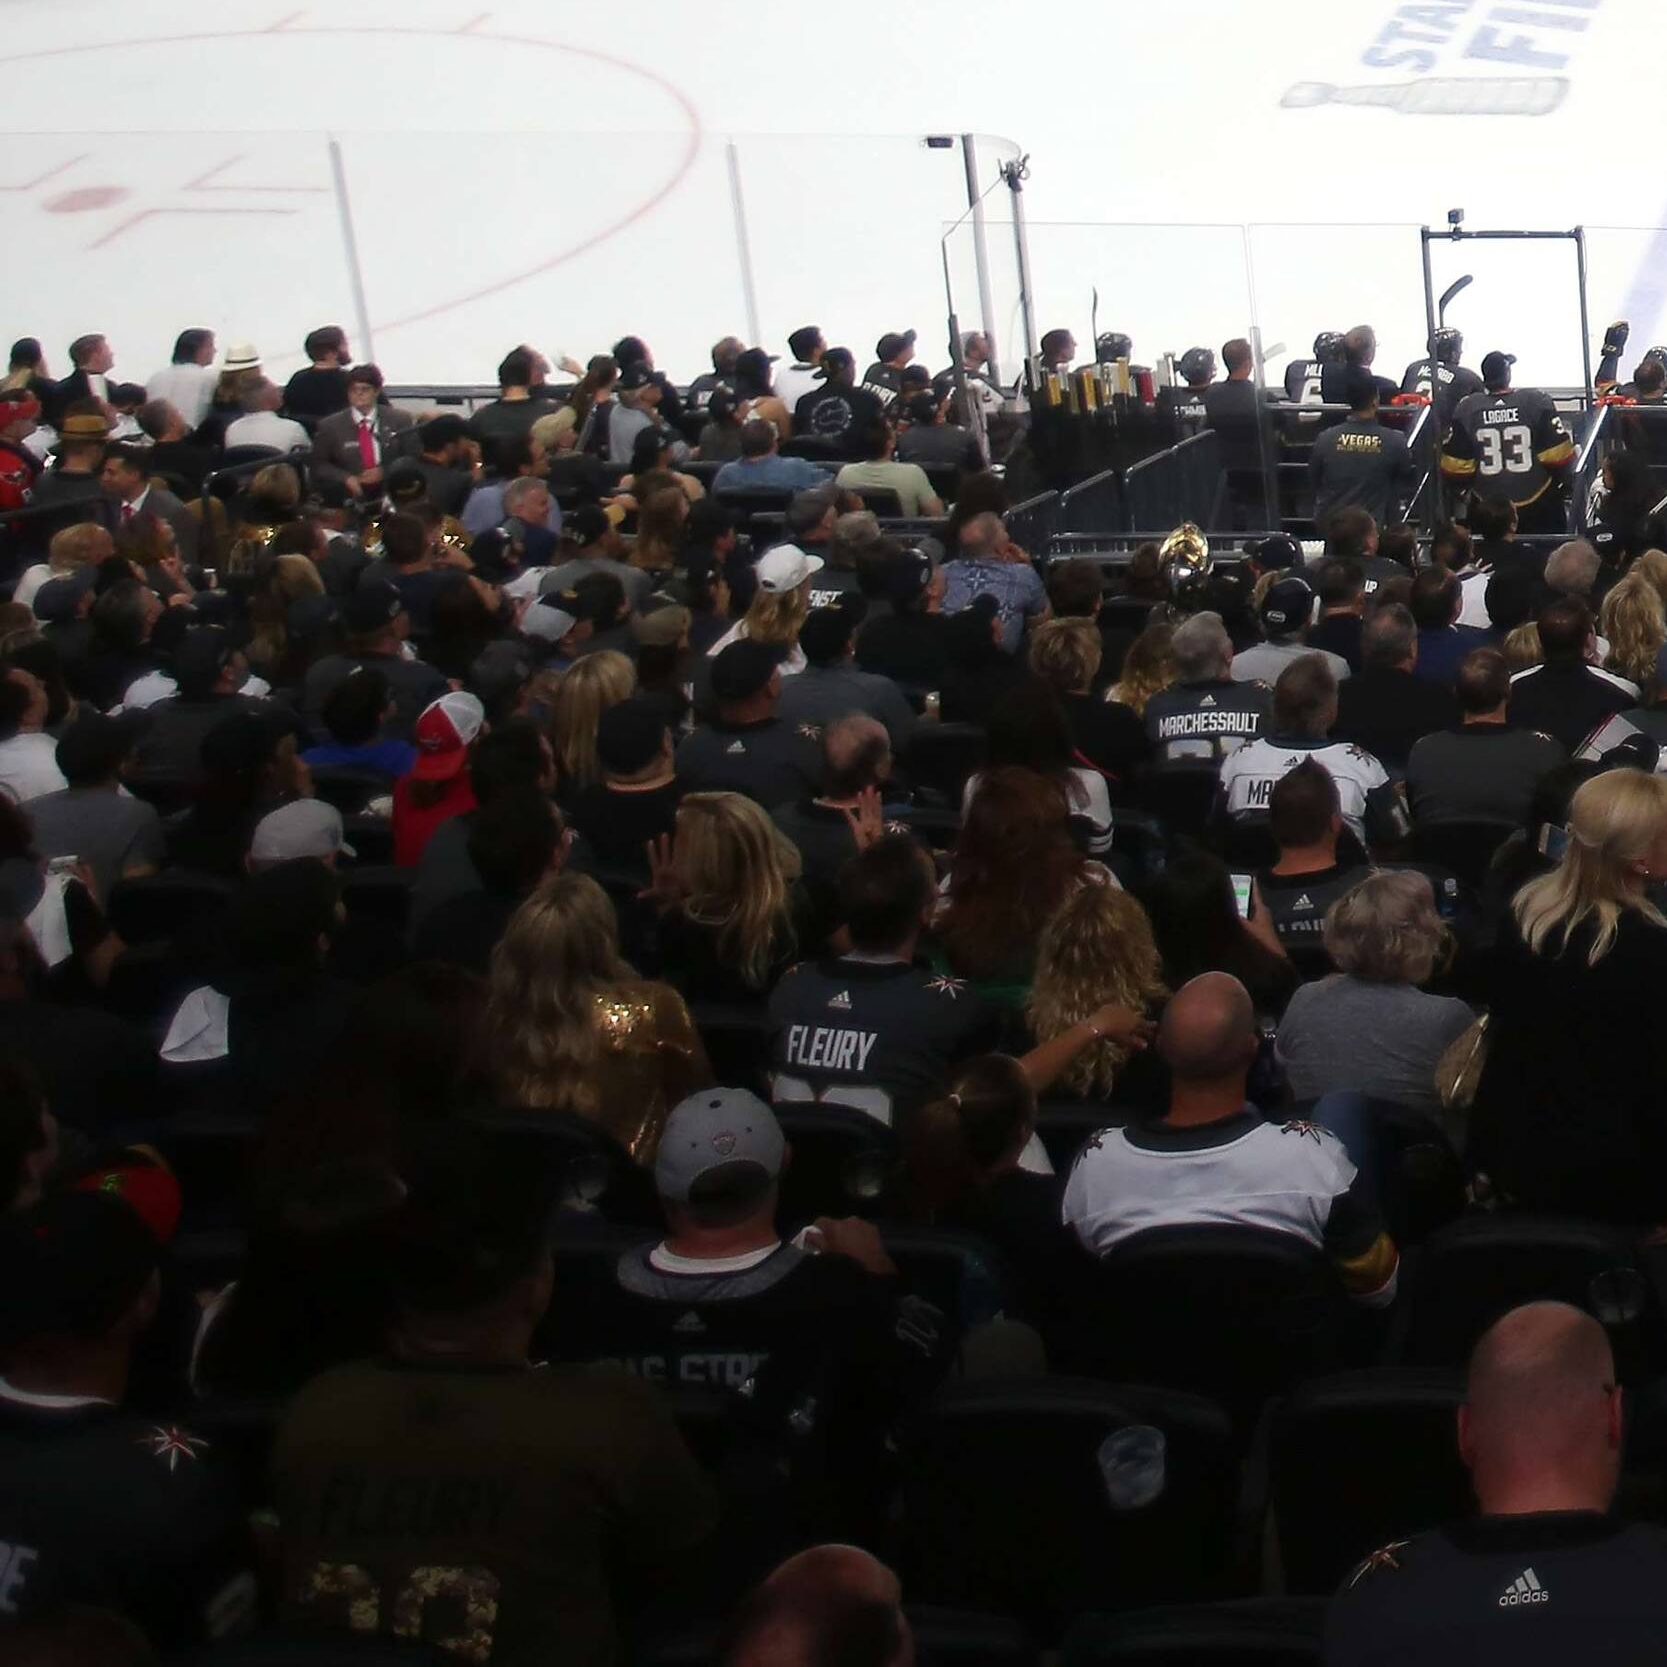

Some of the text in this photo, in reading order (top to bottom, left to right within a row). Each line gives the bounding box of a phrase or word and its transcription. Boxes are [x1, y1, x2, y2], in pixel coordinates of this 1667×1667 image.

[1477, 425, 1533, 475] 33
[1159, 711, 1260, 738] MARCHESSAULT
[786, 1022, 878, 1072] FLEURY
[1499, 1589, 1551, 1607] adidas
